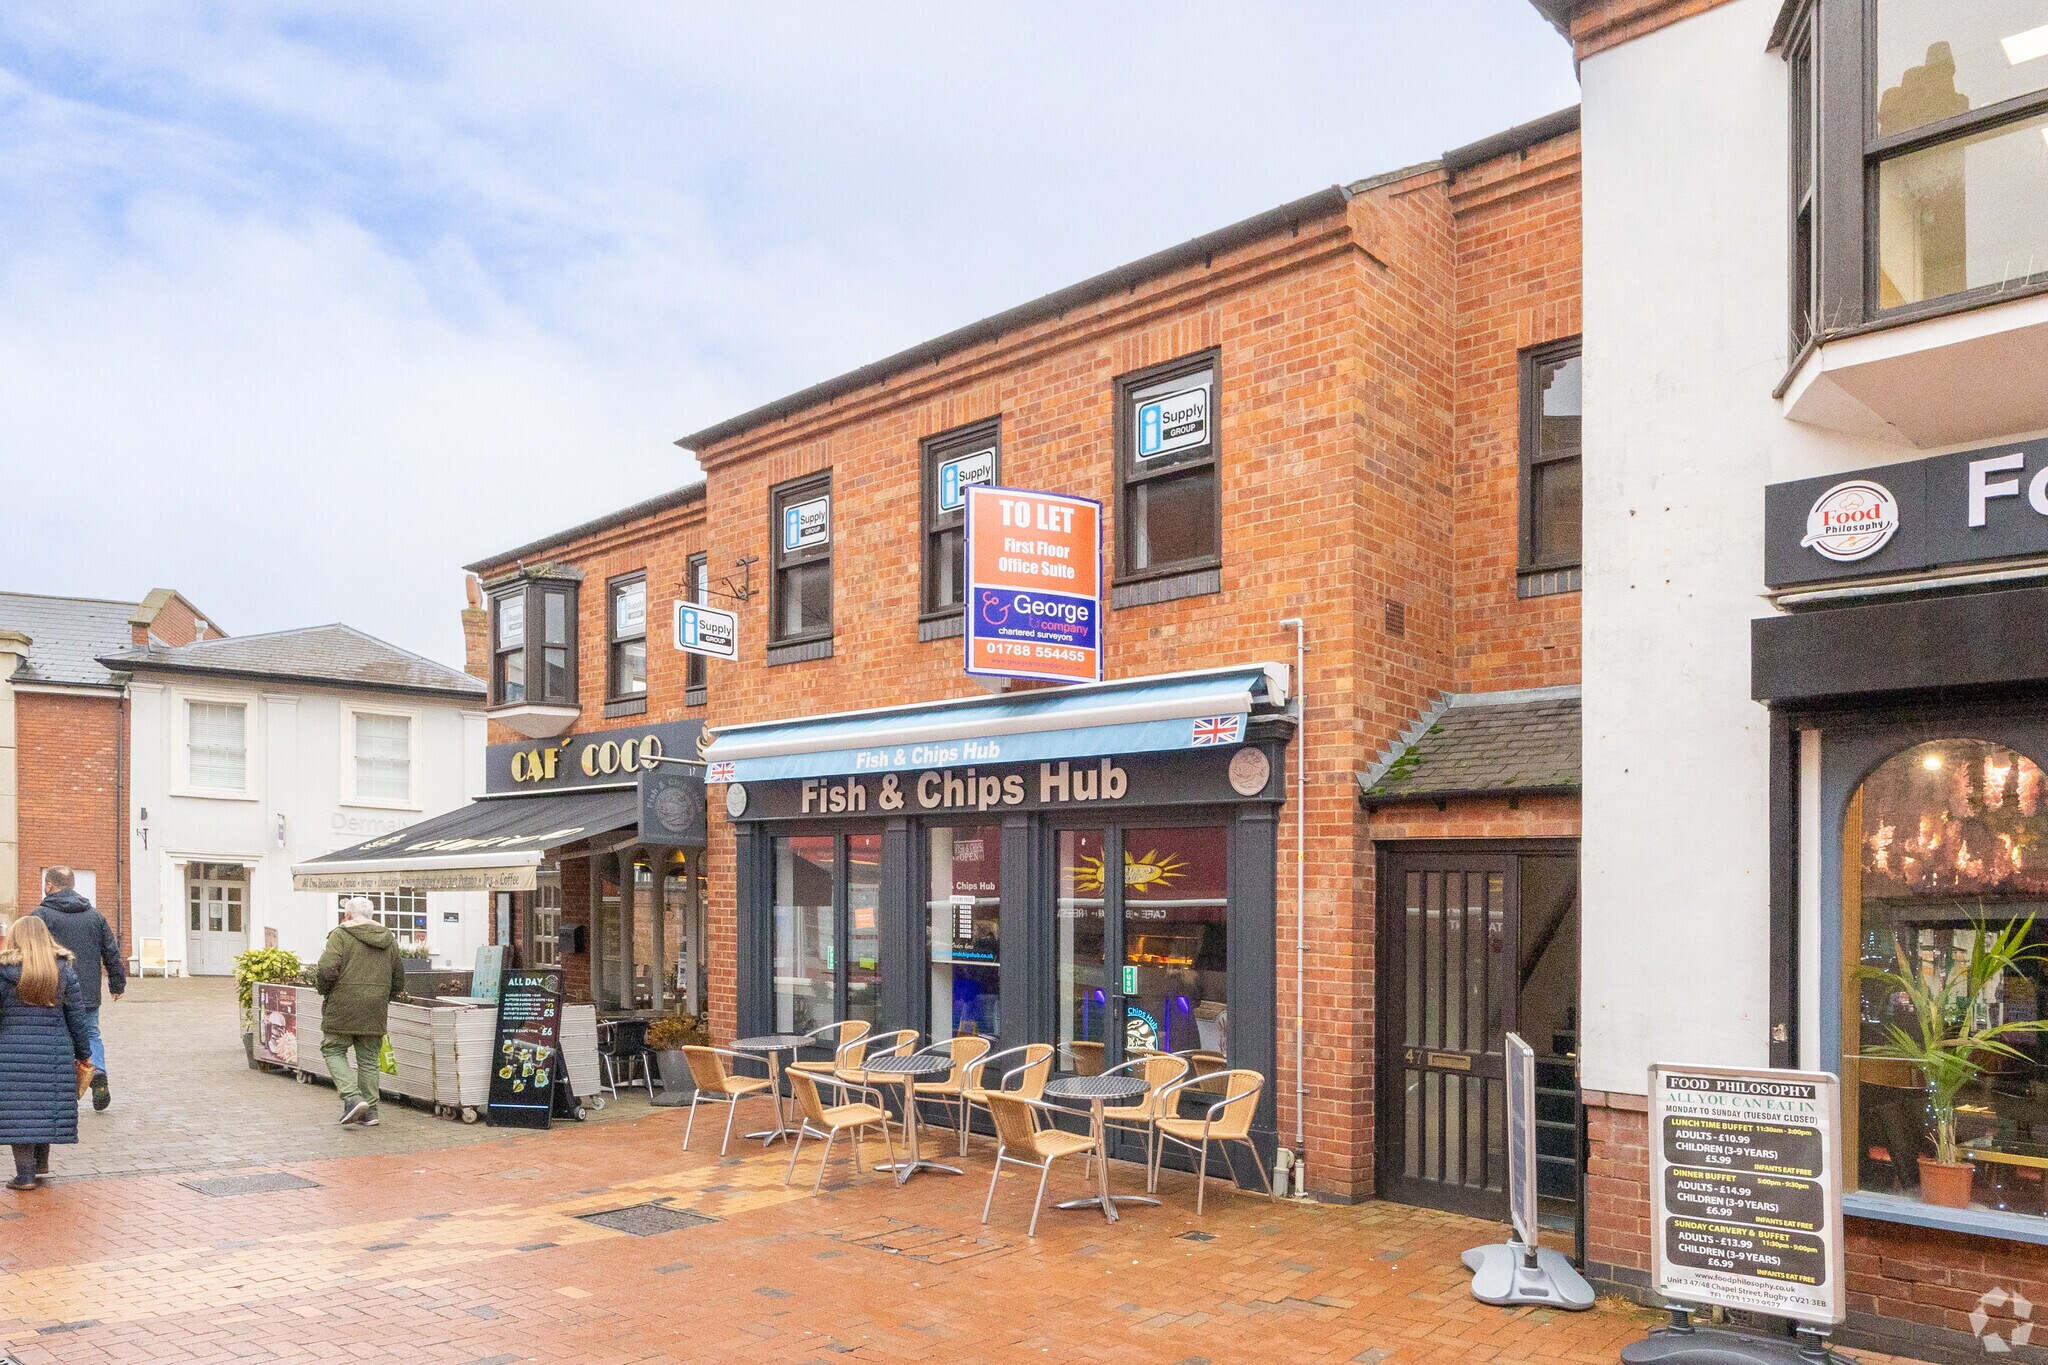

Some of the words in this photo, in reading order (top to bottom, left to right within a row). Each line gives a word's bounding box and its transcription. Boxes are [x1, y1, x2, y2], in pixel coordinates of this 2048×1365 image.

[1162, 404, 1203, 423] Supply
[1170, 424, 1196, 436] GROUP
[959, 464, 991, 482] Supply
[800, 510, 825, 525] Supply
[999, 499, 1031, 529] TO
[1037, 503, 1074, 534] LET
[1822, 503, 1881, 527] Food
[805, 526, 821, 536] GROUP
[1825, 519, 1884, 534] Philosophy
[1004, 537, 1035, 554] First
[1037, 541, 1070, 559] Floor
[998, 557, 1039, 575] Office
[1041, 561, 1075, 580] Suite
[627, 601, 644, 611] Supply
[1013, 594, 1089, 623] George
[699, 620, 732, 637] Supply
[998, 627, 1035, 638] chartered
[1036, 631, 1073, 642] surveyors
[1041, 621, 1088, 637] company
[705, 635, 726, 645] GROUP
[986, 642, 1031, 656] 01788
[1035, 647, 1085, 662] 554455
[581, 734, 662, 777] COCO
[856, 751, 889, 769] Fish
[893, 748, 906, 766] &
[911, 745, 958, 767] Chips
[962, 740, 1001, 760] Hub
[801, 776, 866, 814] Fish
[879, 773, 905, 811] &
[917, 768, 1025, 812] Chips
[1040, 757, 1128, 803] Hub
[483, 873, 493, 886] Tea
[500, 872, 519, 887] Coffee
[956, 881, 978, 891] Chips
[979, 881, 996, 890] Hub
[507, 977, 524, 986] ALL
[524, 977, 543, 986] DAY
[543, 1009, 555, 1018] £5
[1127, 1007, 1146, 1018] Chips
[1145, 1014, 1159, 1030] Hub
[541, 1027, 553, 1036] £6
[1405, 1048, 1423, 1065] 47
[1670, 1077, 1710, 1090] FOOD
[1716, 1080, 1811, 1098] PHILOSOPHY
[1667, 1092, 1695, 1104] ALL
[1698, 1094, 1728, 1106] YOU
[1732, 1097, 1762, 1108] CAN
[1766, 1099, 1795, 1111] EAT
[1799, 1102, 1815, 1113] IN
[1665, 1104, 1698, 1114] MONDAY
[1700, 1107, 1710, 1115] TO
[1711, 1108, 1741, 1118] SUNDAY
[1743, 1111, 1781, 1121] (TUESDAY
[1783, 1114, 1818, 1125] CLOSED)
[1671, 1118, 1699, 1127] LUNCH
[1700, 1121, 1720, 1129] TIME
[1722, 1123, 1754, 1132] BUFFET
[1756, 1126, 1784, 1134] 11:30am
[1787, 1128, 1812, 1137] 3:00pm
[1675, 1130, 1712, 1141] ADULTS
[1718, 1134, 1750, 1144] £10.99
[1675, 1142, 1723, 1154] CHILDREN
[1724, 1146, 1743, 1155] (3-9
[1744, 1148, 1778, 1160] YEARS)
[1705, 1155, 1732, 1164] £5.99
[1673, 1169, 1704, 1179] DINNER
[1705, 1172, 1737, 1182] BUFFET
[1754, 1163, 1782, 1173] INFANTS
[1796, 1168, 1813, 1176] FREE
[1677, 1180, 1713, 1192] ADULTS
[1719, 1186, 1752, 1196] £14.99
[1757, 1178, 1781, 1187] 5:00pm
[1785, 1181, 1810, 1190] 9:30pm
[1677, 1192, 1724, 1205] CHILDREN
[1725, 1197, 1744, 1207] (3-9
[1745, 1200, 1779, 1213] YEARS)
[1706, 1206, 1733, 1217] £6.99
[1674, 1219, 1708, 1231] SUNDAY
[1708, 1225, 1748, 1236] CARVERY
[1749, 1229, 1756, 1237] &
[1758, 1230, 1790, 1241] BUFFET
[1755, 1216, 1784, 1226] INFANTS
[1784, 1220, 1796, 1228] EAT
[1797, 1222, 1814, 1230] FREE
[1678, 1231, 1714, 1244] ADULTS
[1720, 1237, 1753, 1249] £13.99
[1762, 1240, 1790, 1249] 11:30pm
[1793, 1244, 1818, 1253] 9:00pm
[1678, 1243, 1725, 1258] CHILDREN
[1726, 1250, 1745, 1260] (3-9
[1746, 1252, 1781, 1266] YEARS)
[1708, 1258, 1734, 1268] £6.99
[1694, 1272, 1796, 1293] www.foodphilosophy.co.uk
[1756, 1269, 1786, 1279] INFANTS
[1786, 1273, 1798, 1281] EAT
[1799, 1275, 1816, 1284] FREE
[1666, 1276, 1683, 1284] Unit
[1689, 1280, 1711, 1289] 47/48
[1711, 1283, 1737, 1293] Chapel
[1738, 1287, 1763, 1298] Street,
[1763, 1291, 1789, 1302] Rugby
[1789, 1295, 1810, 1304] CV21
[1811, 1299, 1827, 1307] 3EB
